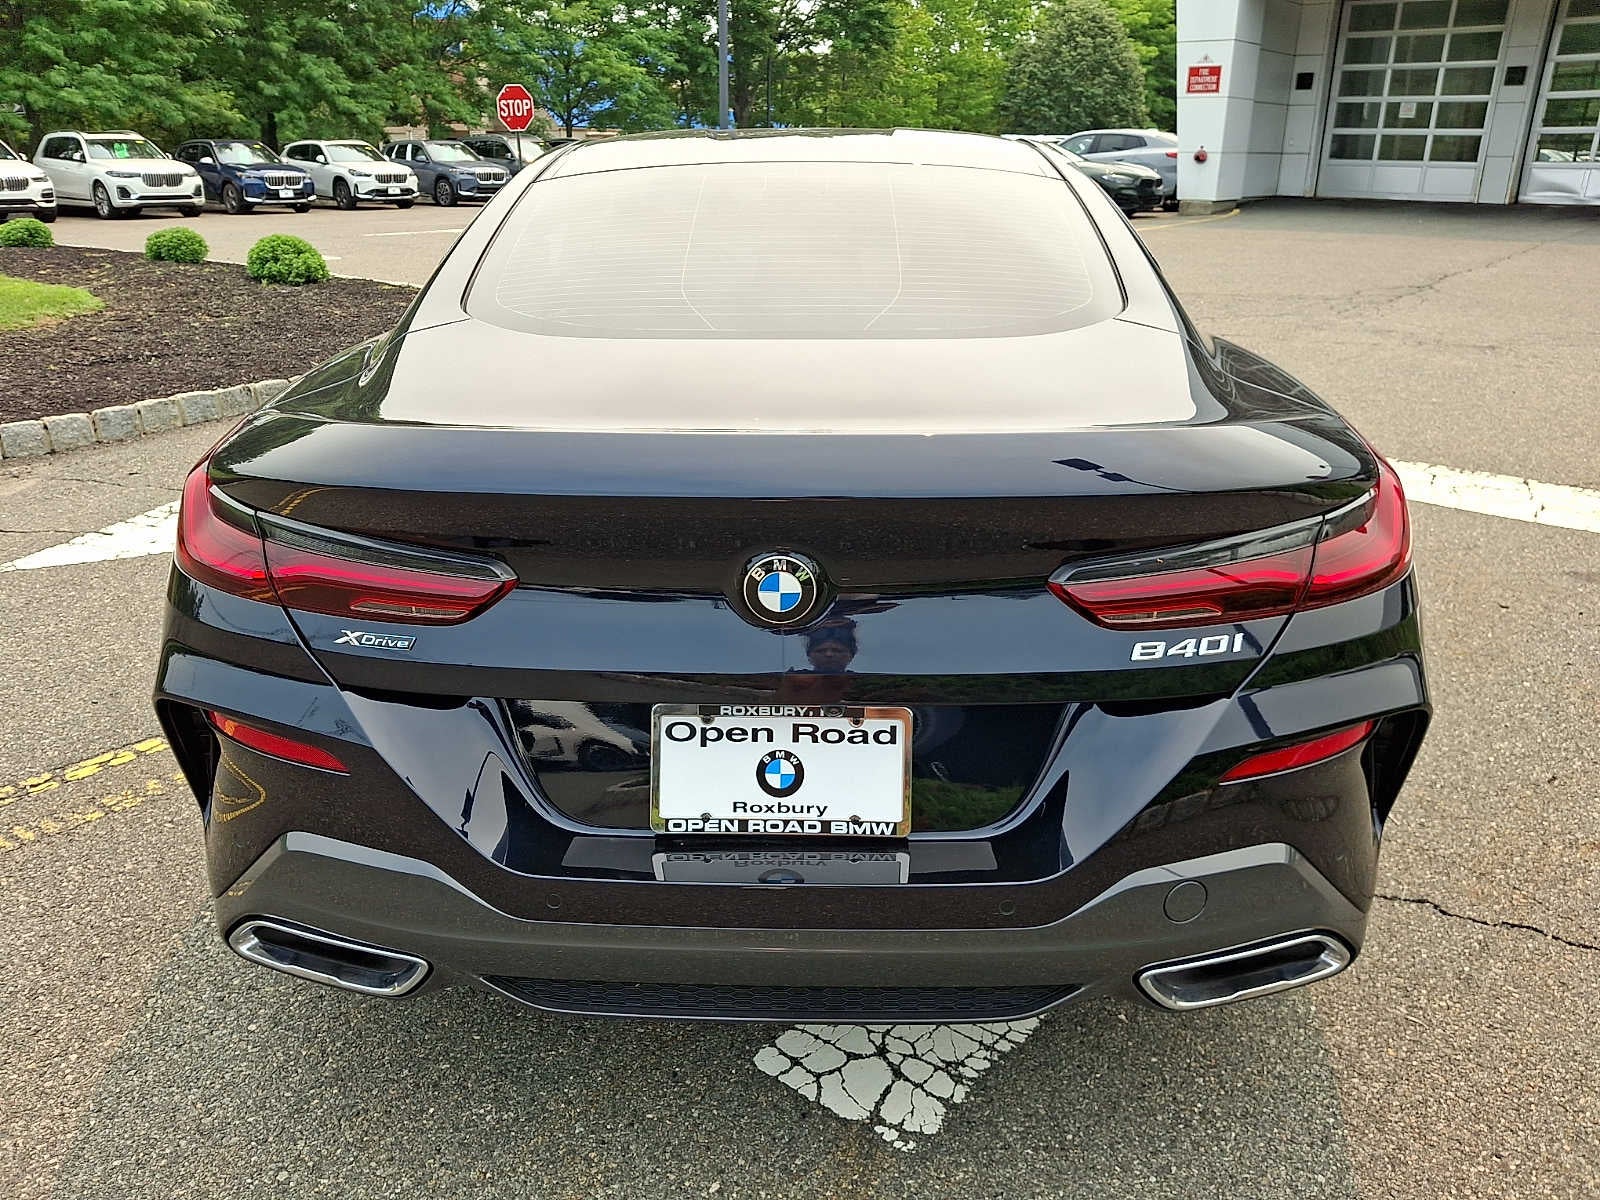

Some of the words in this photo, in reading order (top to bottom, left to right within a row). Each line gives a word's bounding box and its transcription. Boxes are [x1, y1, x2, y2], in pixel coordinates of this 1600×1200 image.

[500, 99, 530, 117] STOP
[751, 559, 811, 582] BMW
[664, 721, 774, 747] Open
[791, 723, 897, 745] Road
[762, 750, 800, 765] BMW
[732, 801, 829, 817] Roxbury
[667, 819, 739, 833] OPEN
[748, 820, 822, 834] ROAD
[830, 821, 894, 836] BMW
